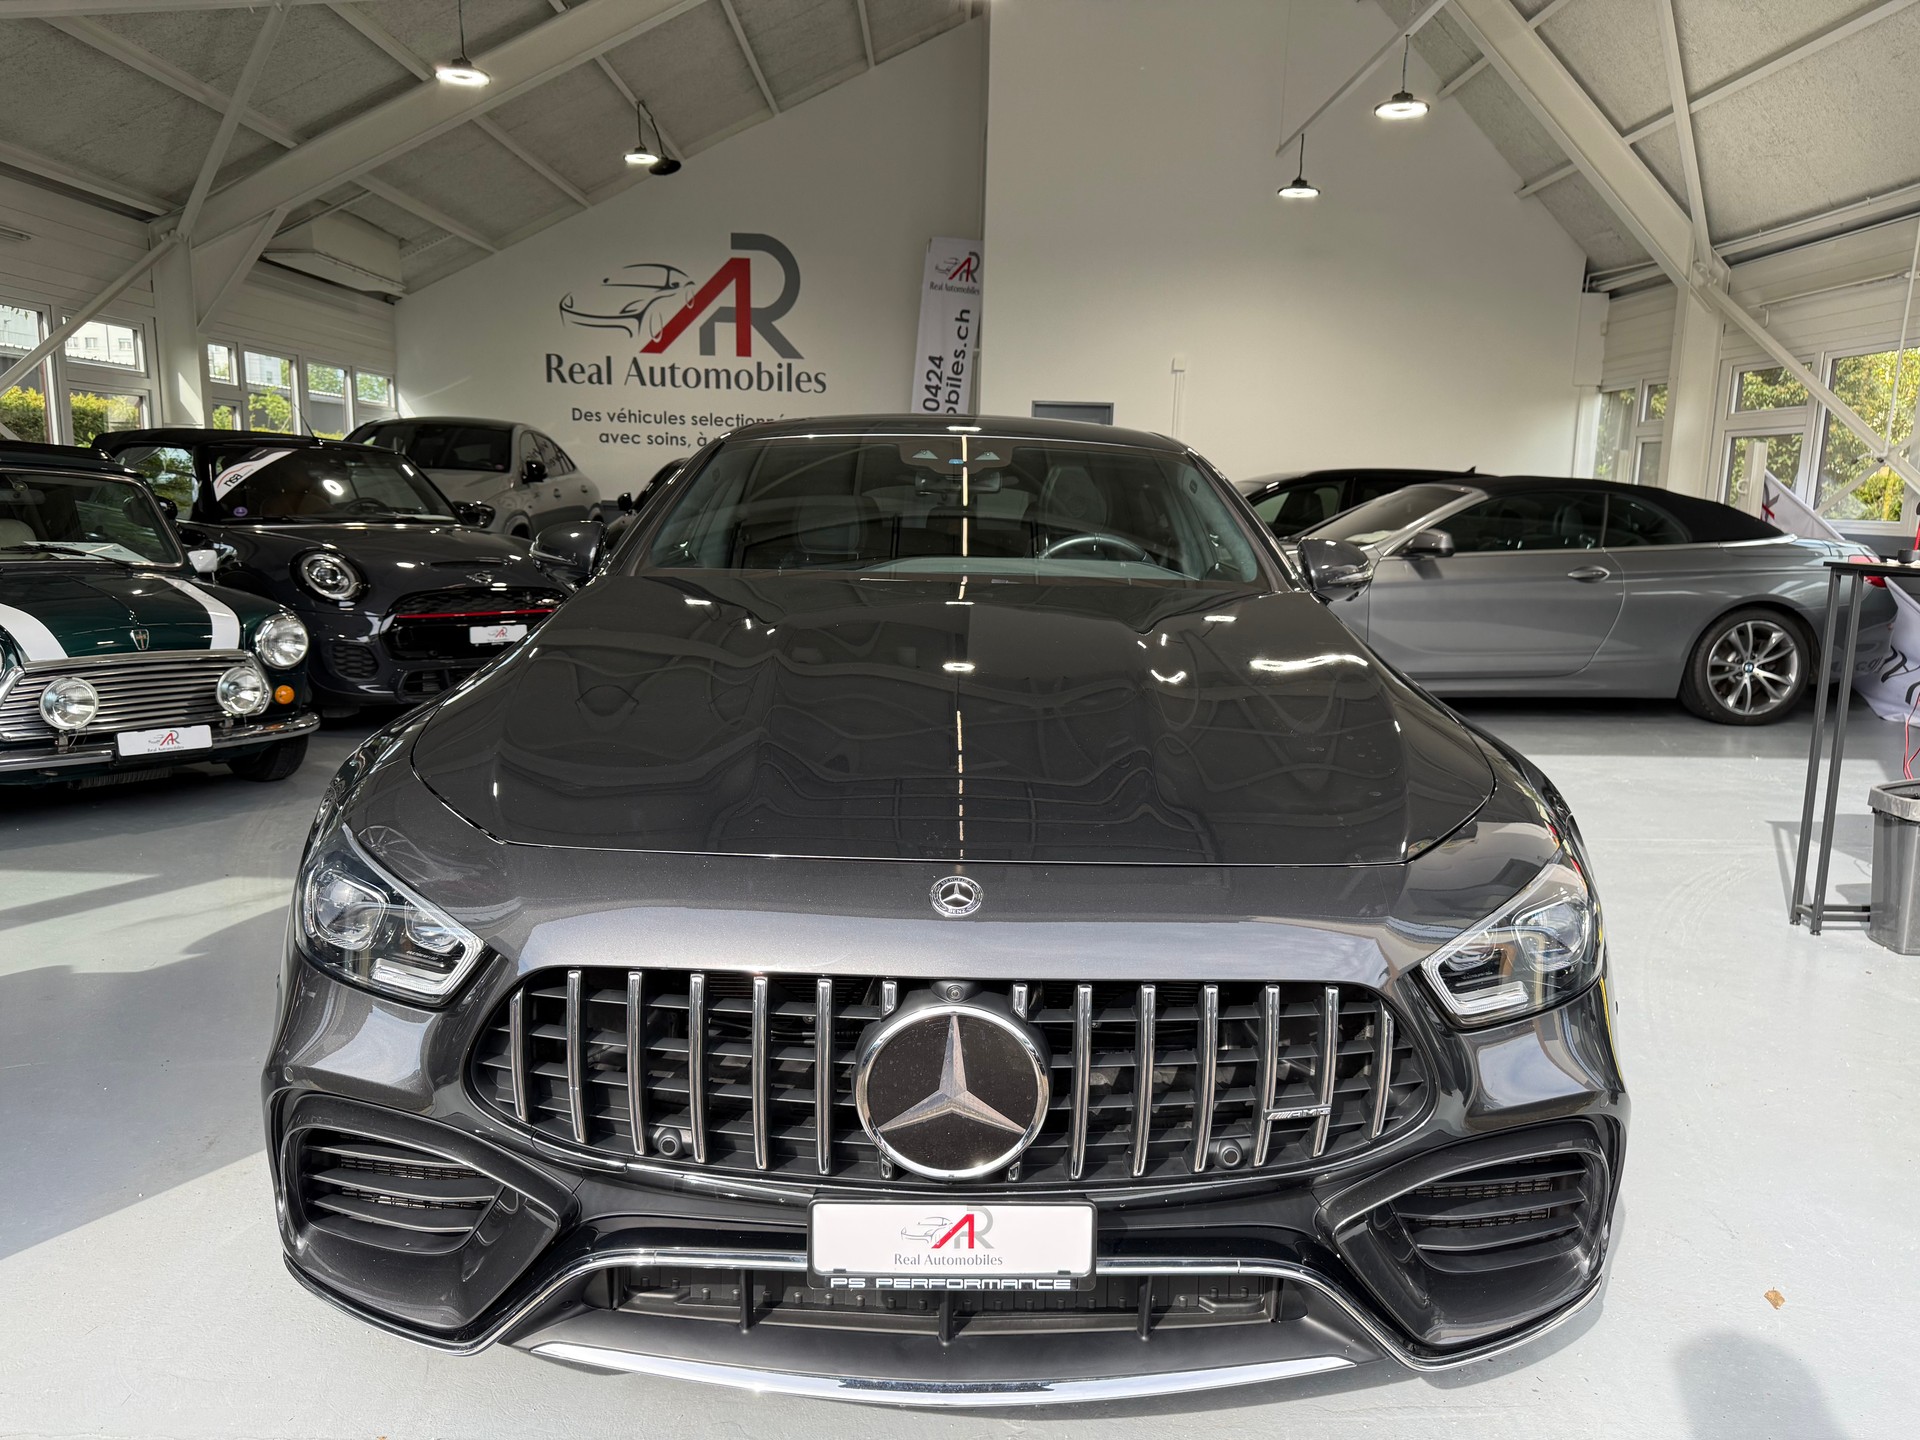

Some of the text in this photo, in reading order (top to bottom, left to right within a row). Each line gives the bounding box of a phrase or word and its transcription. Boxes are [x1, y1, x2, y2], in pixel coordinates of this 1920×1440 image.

[929, 281, 980, 296] Real Automobiles
[545, 353, 827, 394] Real Automobiles
[922, 355, 944, 412] 0424
[571, 407, 602, 422] Des
[606, 407, 686, 425] véhicules
[599, 431, 707, 448] avec soins, à
[894, 1253, 1003, 1267] Real Automobiles
[830, 1277, 1072, 1290] PS PERFORMANCE
